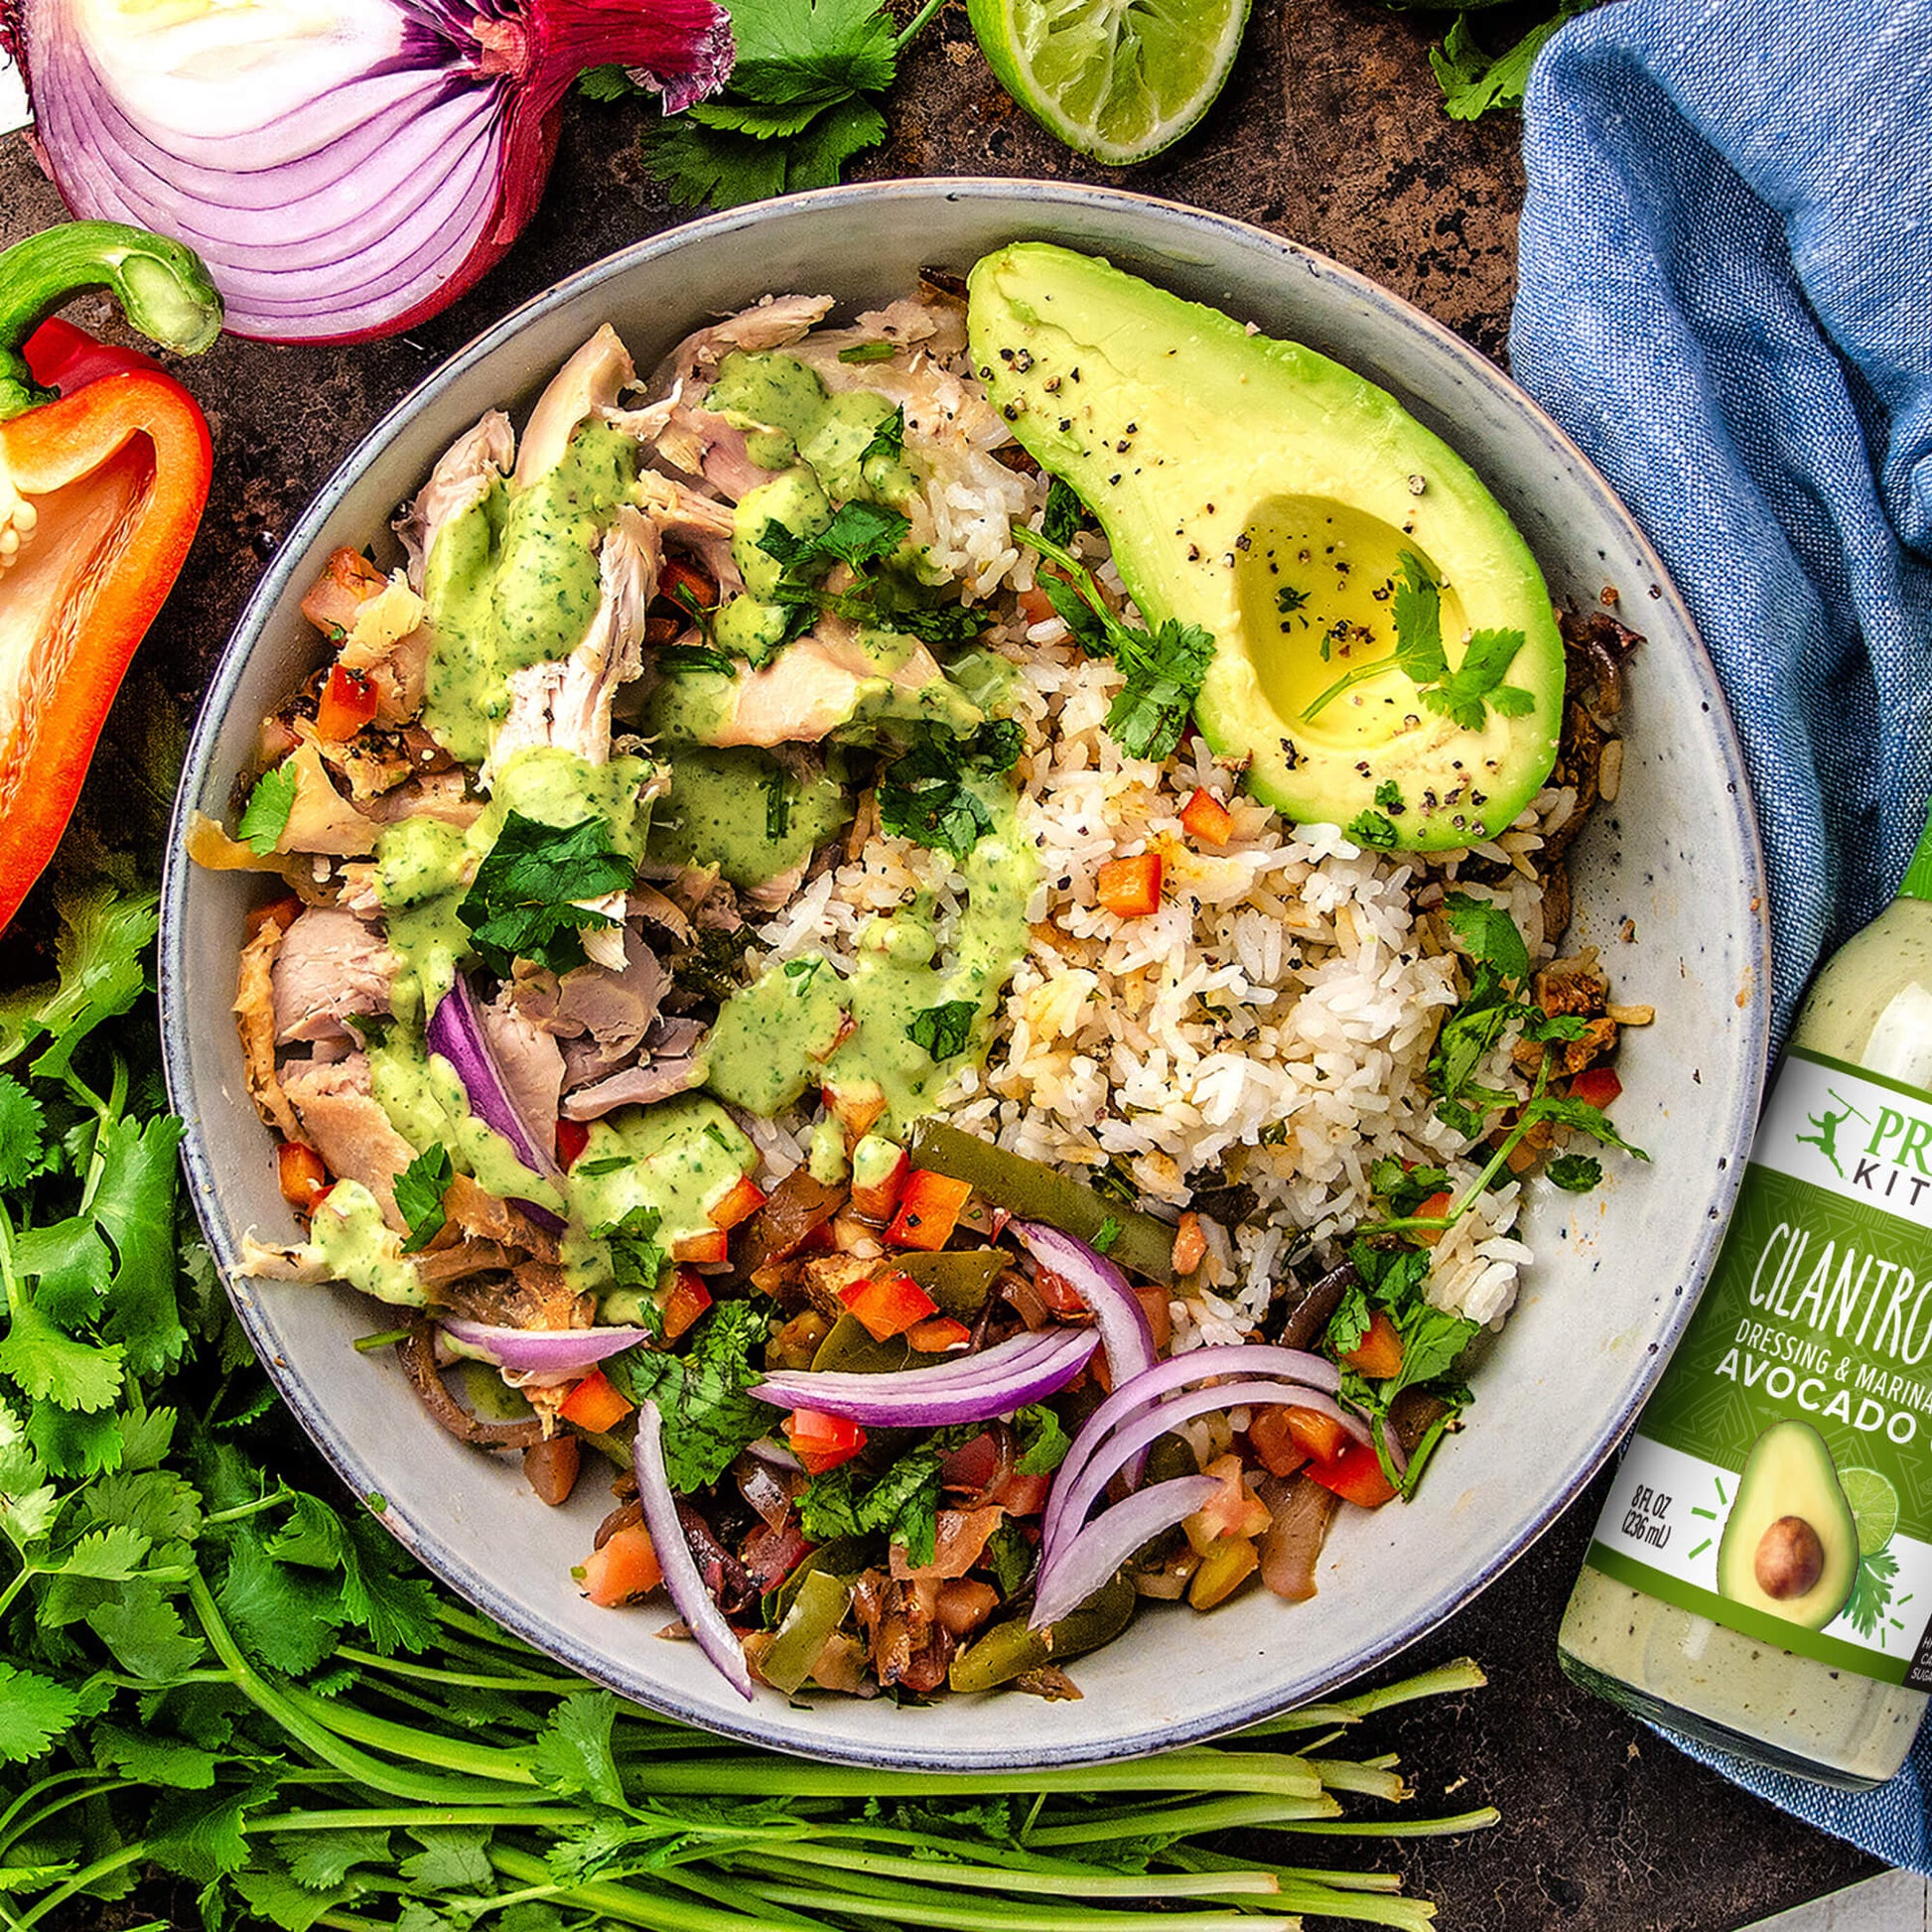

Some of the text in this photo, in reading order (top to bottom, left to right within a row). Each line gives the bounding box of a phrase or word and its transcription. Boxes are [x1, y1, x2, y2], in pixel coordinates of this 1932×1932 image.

[1853, 1158, 1931, 1206] KIT
[1749, 1222, 1932, 1365] CILANTRO
[1735, 1318, 1832, 1374] DRESSING
[1834, 1356, 1851, 1382] &
[1715, 1347, 1916, 1444] AVOCADO
[1621, 1508, 1672, 1549] (236 mL)
[1652, 1493, 1672, 1519] OZ
